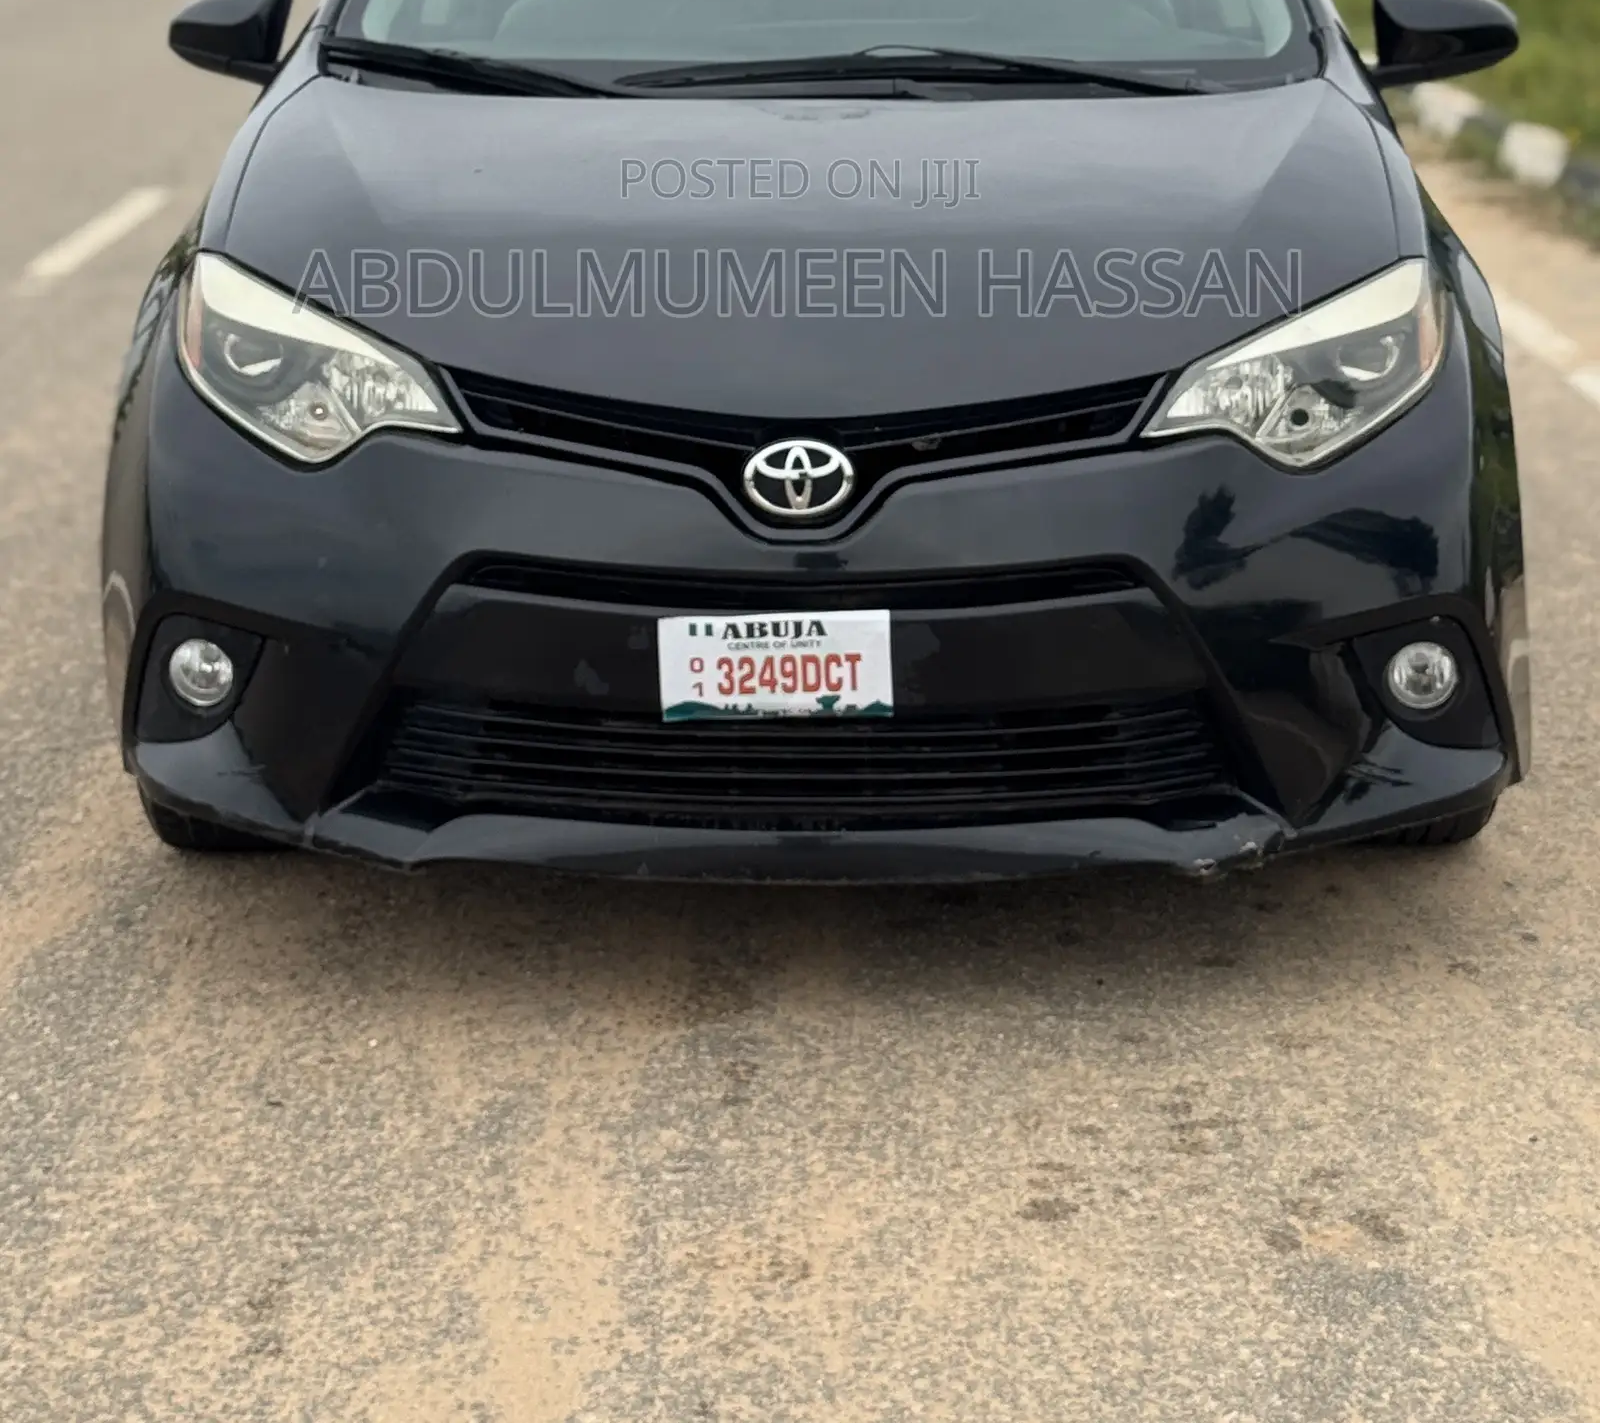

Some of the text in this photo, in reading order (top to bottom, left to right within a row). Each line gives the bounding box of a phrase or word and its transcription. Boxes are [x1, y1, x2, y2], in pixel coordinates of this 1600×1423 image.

[721, 620, 828, 640] ABUJA
[727, 639, 823, 651] CENTRE OF UNITY
[716, 653, 862, 696] 3249DCT
